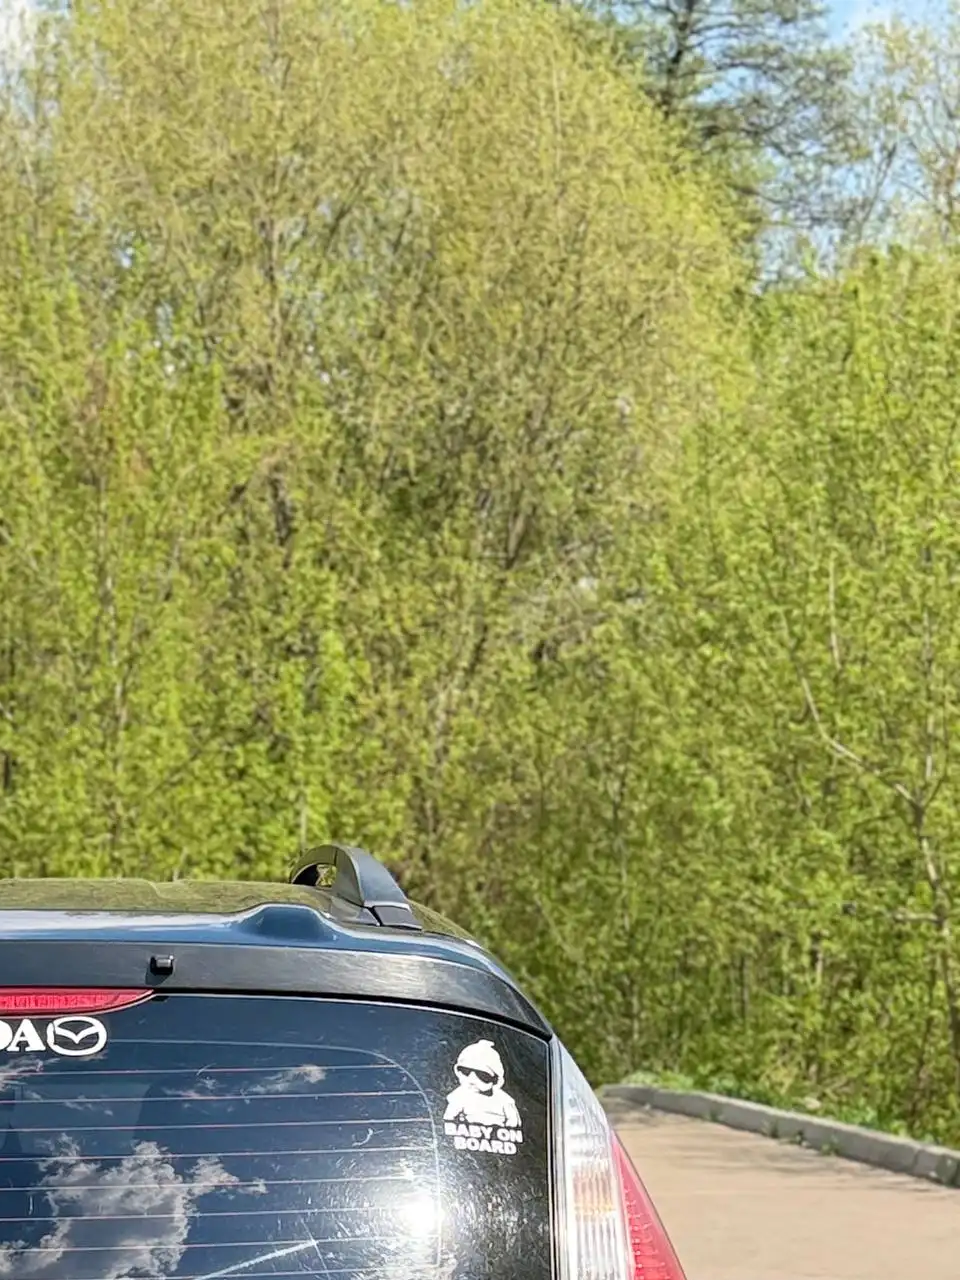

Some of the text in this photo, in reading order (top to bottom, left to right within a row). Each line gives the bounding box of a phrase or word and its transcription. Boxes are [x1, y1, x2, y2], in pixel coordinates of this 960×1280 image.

[444, 1122, 523, 1142] BABY ON
[454, 1137, 517, 1154] BOARD
